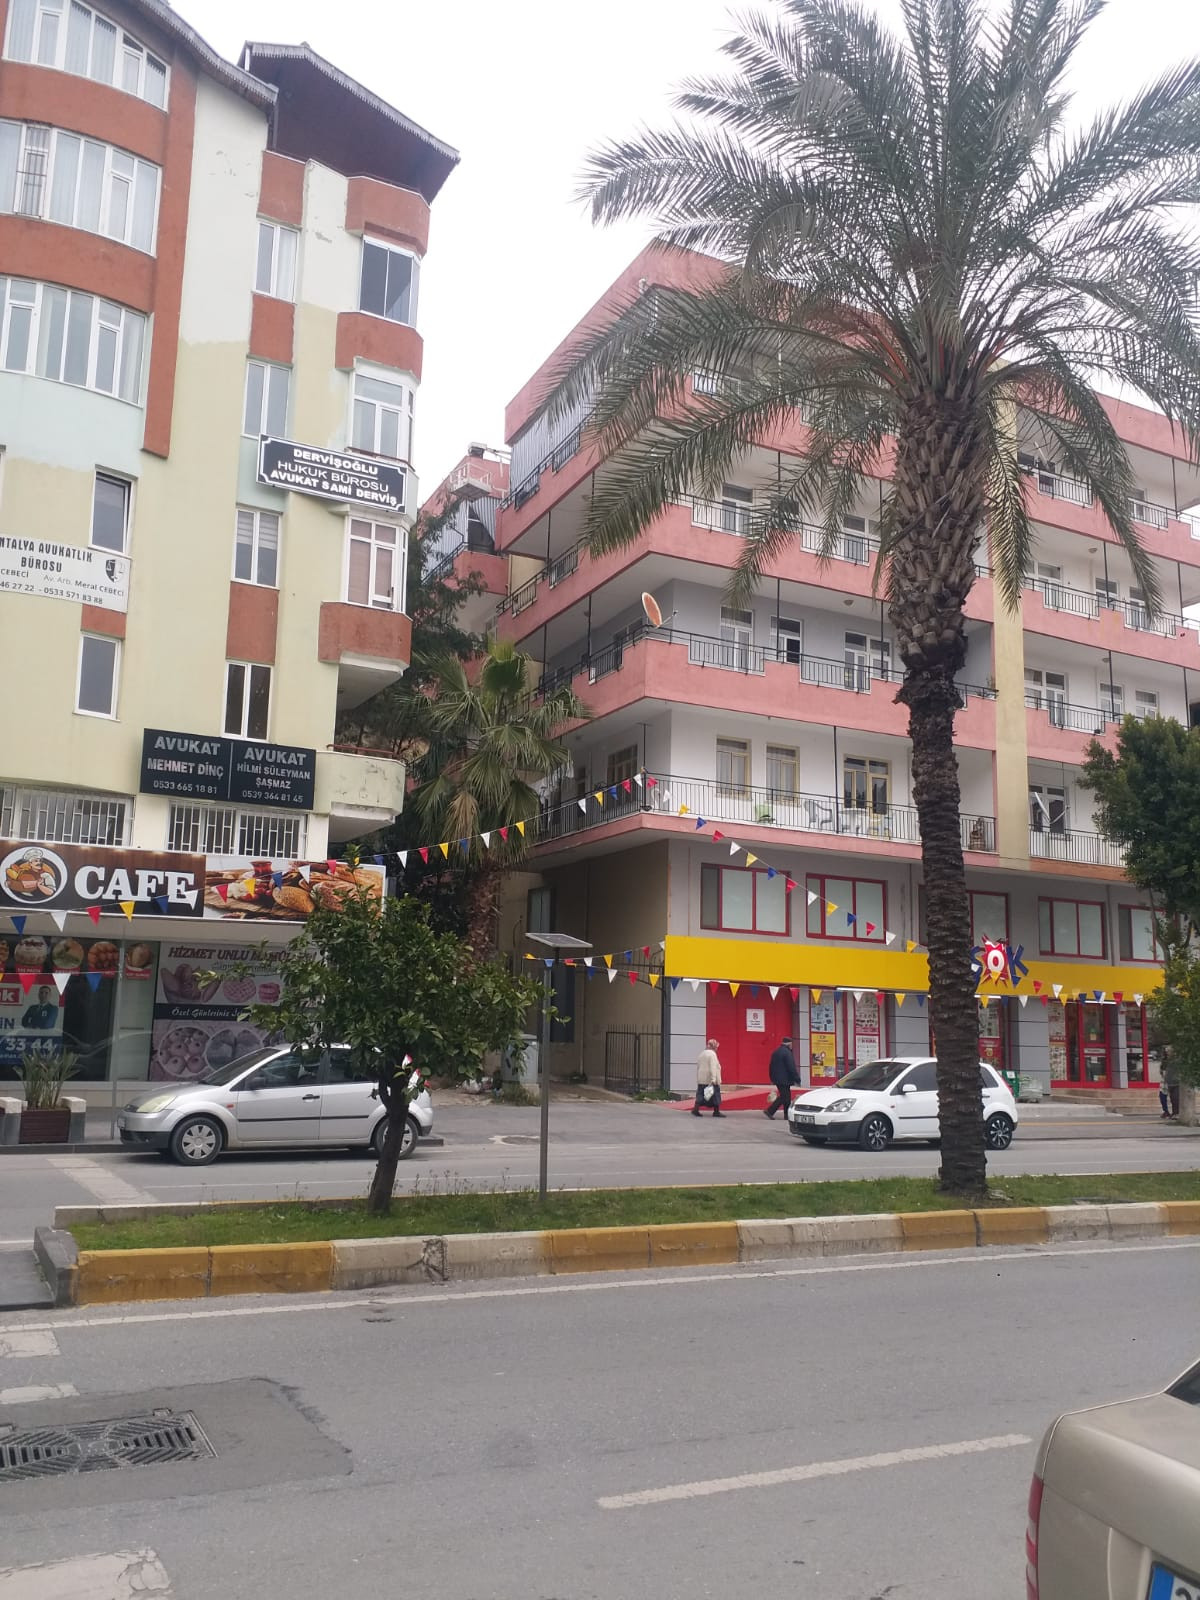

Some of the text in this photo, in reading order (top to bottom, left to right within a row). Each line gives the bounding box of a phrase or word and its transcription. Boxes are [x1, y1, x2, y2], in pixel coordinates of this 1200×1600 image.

[293, 449, 378, 475] DERVİŞOĞLU
[277, 460, 389, 493] HUKUK BÜROSU
[270, 470, 397, 507] AVUKAT SAMİ DERVİŞ
[21, 555, 63, 574] BÜROSU
[43, 586, 64, 596] 0533
[65, 590, 80, 599] 571
[74, 580, 98, 591] Meral
[154, 736, 221, 756] AVUKAT
[244, 747, 307, 766] AVUKAT
[147, 757, 224, 780] MEHMET DİNÇ
[237, 761, 311, 780] HİLMİ SÜLEYMAN
[153, 780, 218, 794] 0533 665 18 81
[256, 777, 292, 790] ŞAŞMAZ
[242, 789, 263, 800] 0539
[74, 865, 195, 904] CAFE
[168, 945, 217, 959] HİZMET
[217, 949, 250, 960] UNLU
[171, 1006, 190, 1017] Özel
[191, 1008, 230, 1018] Günleriniz
